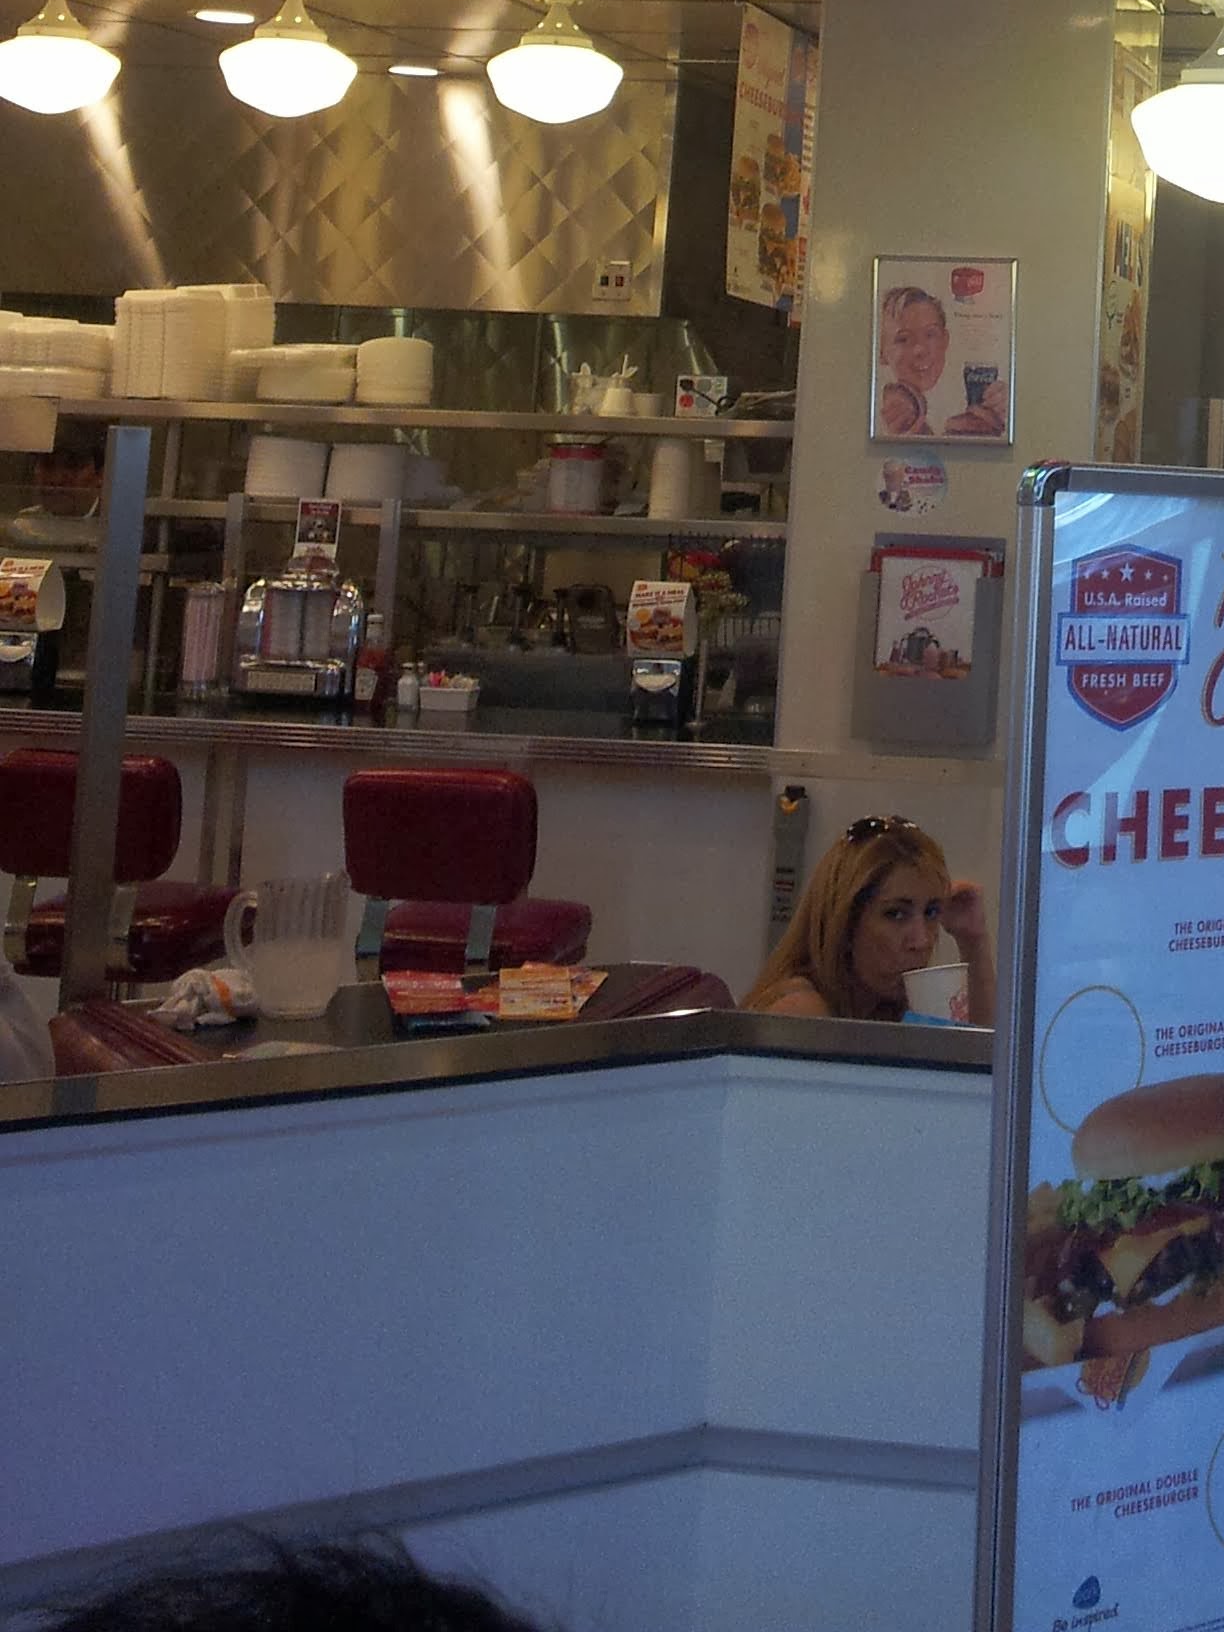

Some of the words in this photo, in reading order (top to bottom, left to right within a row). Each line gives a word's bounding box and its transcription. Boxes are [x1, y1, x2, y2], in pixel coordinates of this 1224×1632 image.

[1084, 591, 1121, 607] U.S.A.
[1125, 592, 1168, 607] Raised
[1064, 624, 1183, 652] ALL-NATURAL
[1082, 673, 1127, 689] FRESH
[1132, 672, 1165, 688] BEEF
[1174, 921, 1193, 935] THE
[1155, 1027, 1174, 1041] THE
[1070, 1496, 1091, 1512] THE
[1096, 1480, 1152, 1507] ORIGINAL
[1156, 1467, 1199, 1491] DOUBLE
[1114, 1485, 1199, 1519] CHEESEBURGER
